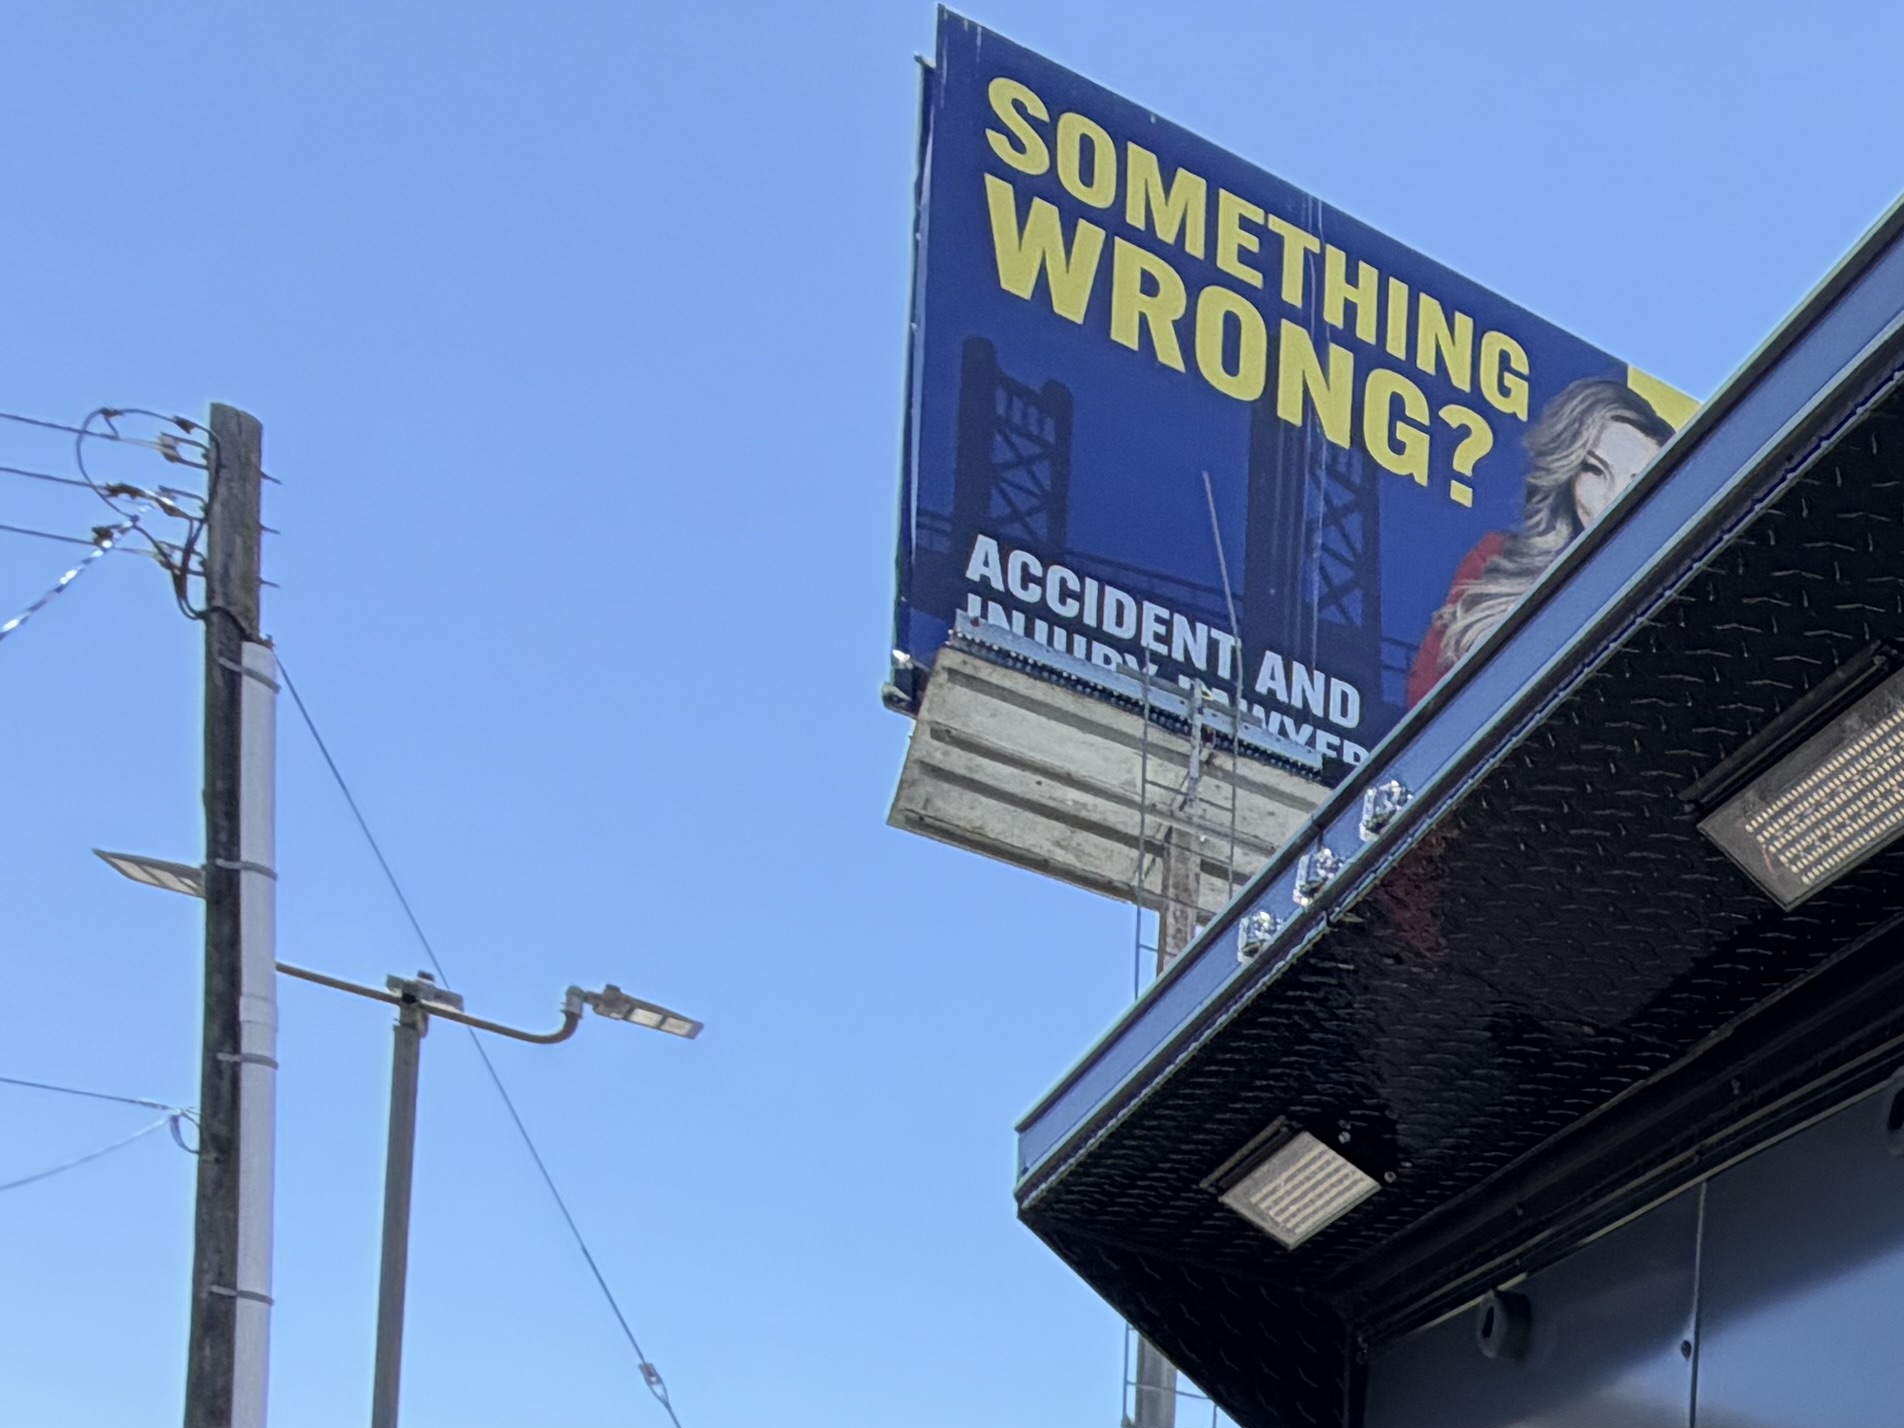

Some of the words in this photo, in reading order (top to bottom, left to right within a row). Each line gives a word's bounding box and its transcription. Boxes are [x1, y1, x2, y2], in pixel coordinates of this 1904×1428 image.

[984, 172, 1495, 508] WRONG?
[986, 77, 1531, 422] SOMETHING
[965, 533, 1242, 681] ACCIDENT
[1254, 650, 1361, 729] AND
